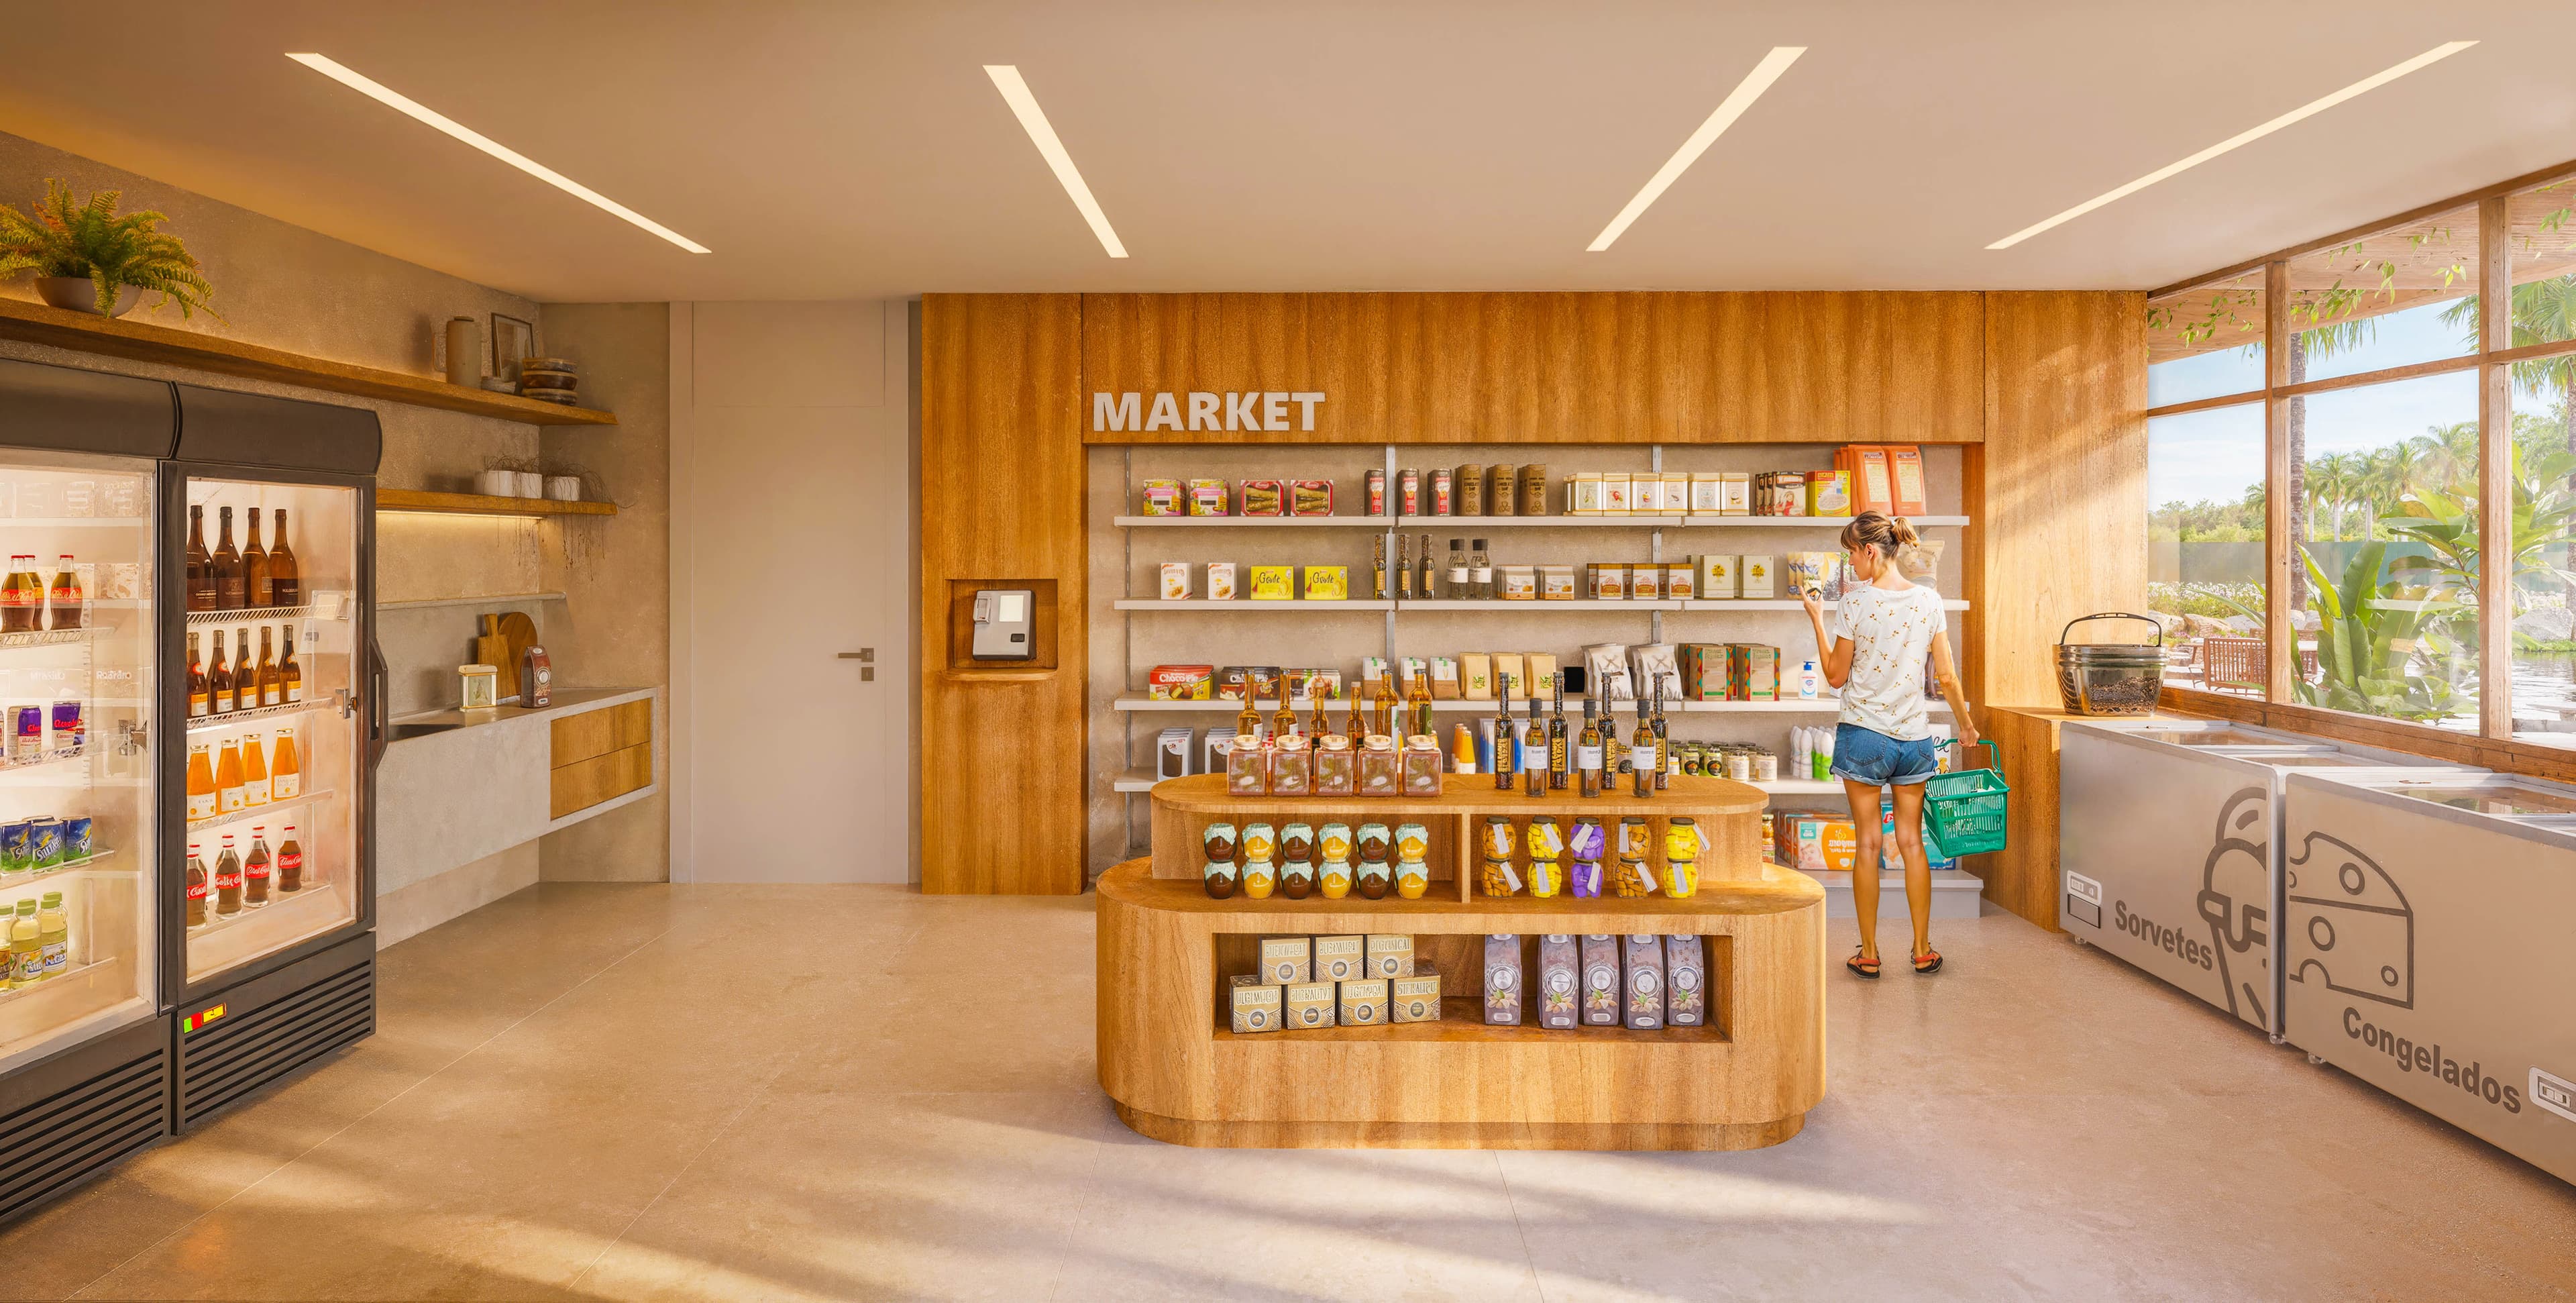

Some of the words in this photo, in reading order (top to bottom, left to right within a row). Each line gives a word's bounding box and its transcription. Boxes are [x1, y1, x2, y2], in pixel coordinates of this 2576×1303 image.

[1093, 392, 1326, 431] MARKET
[2114, 900, 2213, 971] Sorvetes
[2343, 1006, 2522, 1114] Congelados
